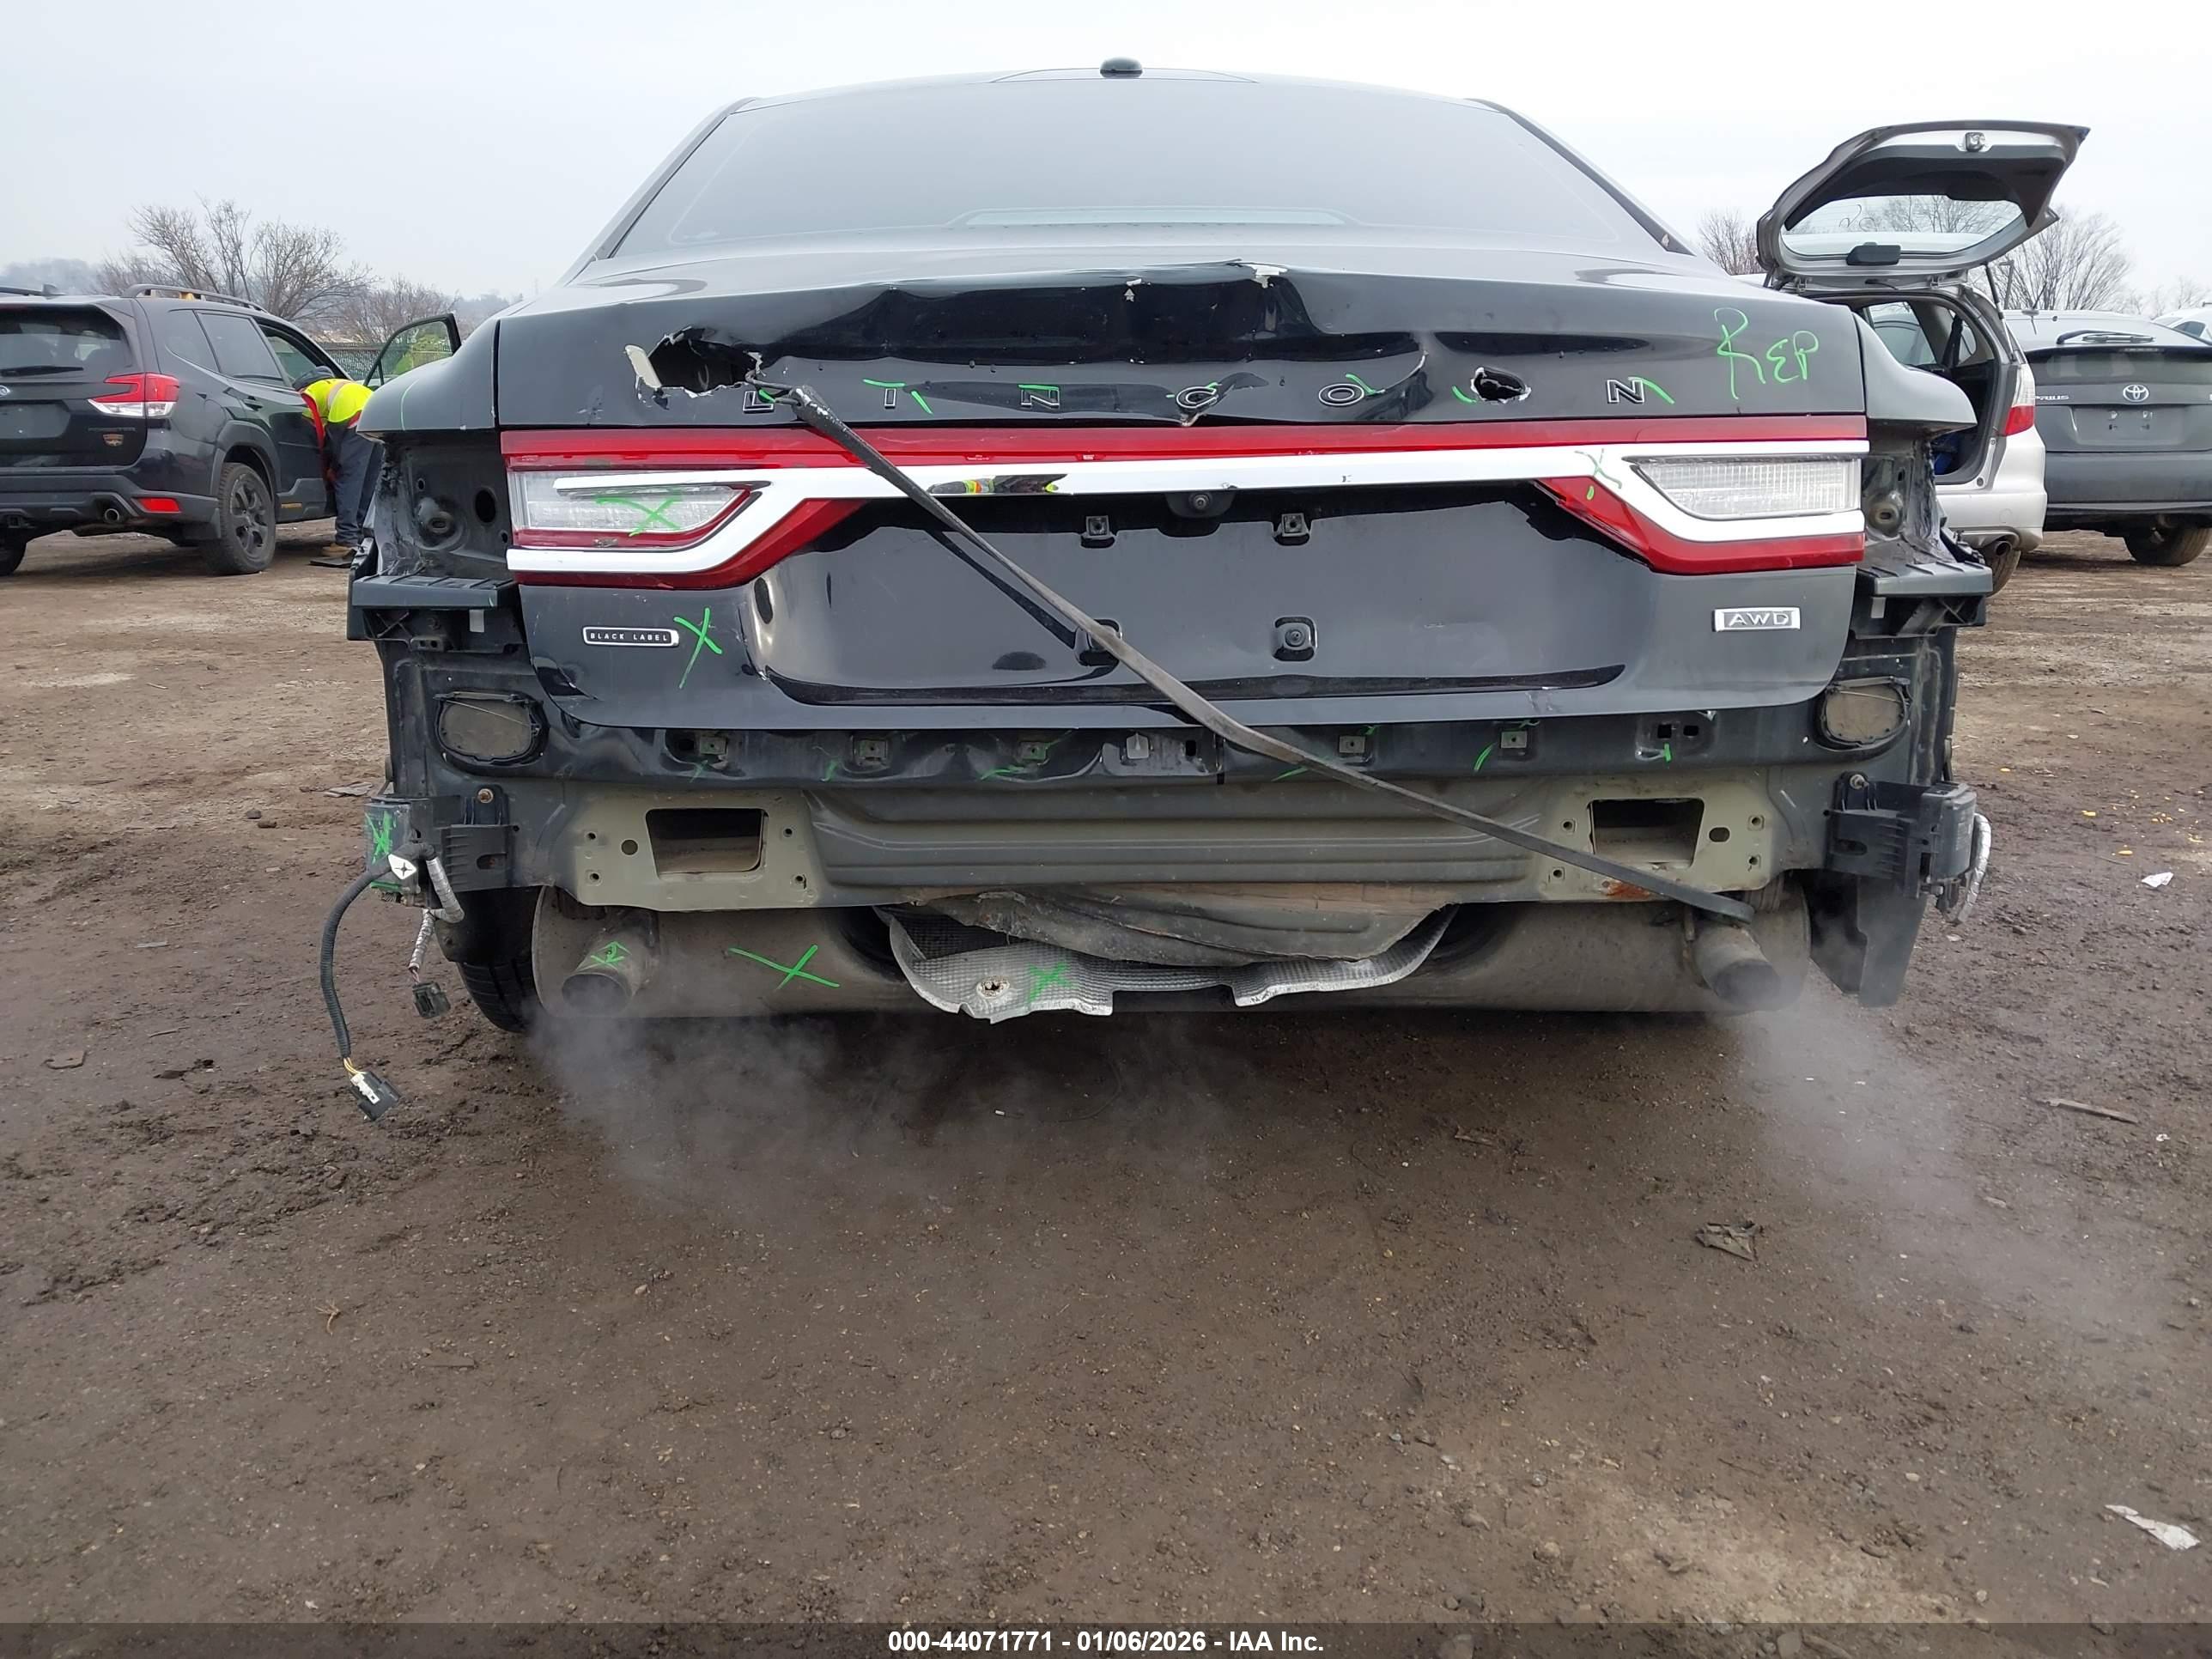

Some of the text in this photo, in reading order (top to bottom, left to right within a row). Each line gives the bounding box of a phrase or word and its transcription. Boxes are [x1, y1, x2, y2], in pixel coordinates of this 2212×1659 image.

[1714, 307, 1819, 400] REP
[743, 379, 1646, 412] LINCON
[1728, 611, 1790, 627] AWD
[589, 632, 625, 641] BLACK
